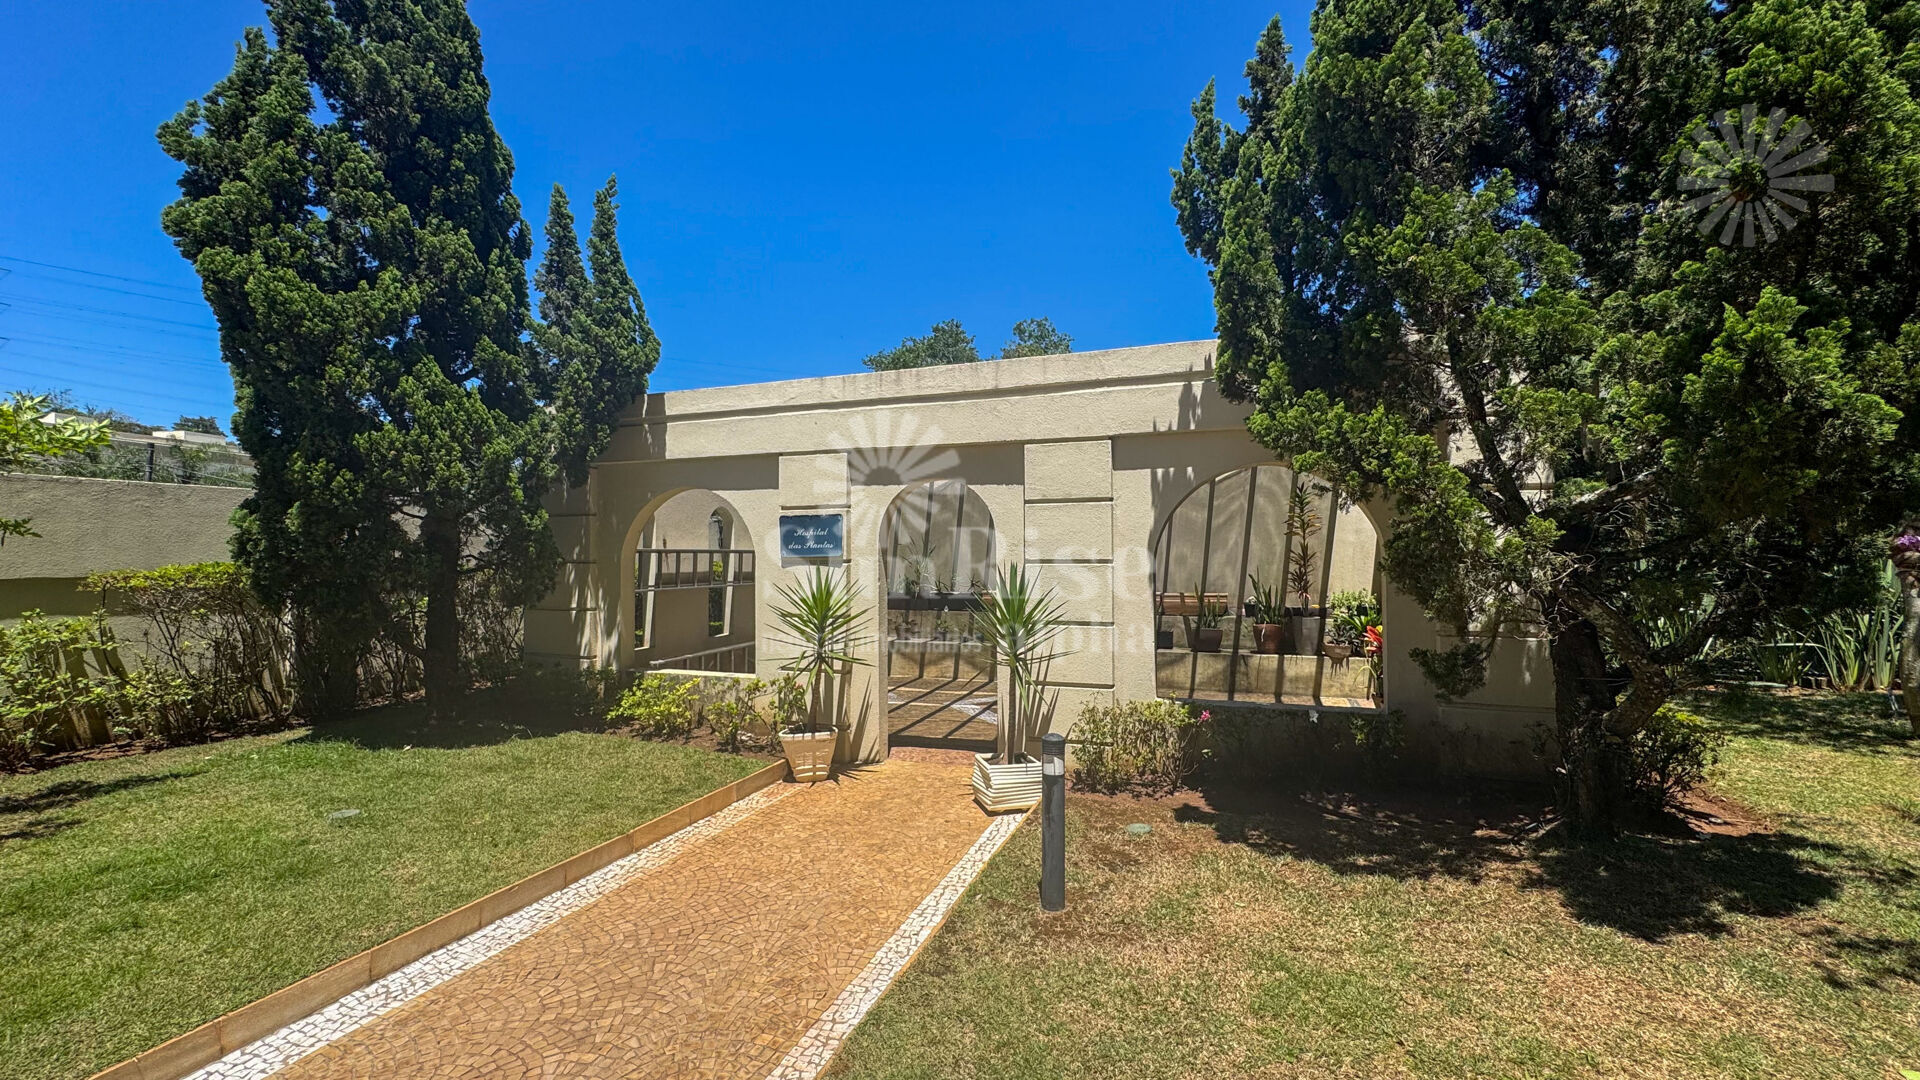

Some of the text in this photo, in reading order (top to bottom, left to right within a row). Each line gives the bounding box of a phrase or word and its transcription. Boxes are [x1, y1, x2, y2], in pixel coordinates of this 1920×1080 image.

[793, 527, 829, 539] Hospital
[788, 540, 834, 549] das Plantas
